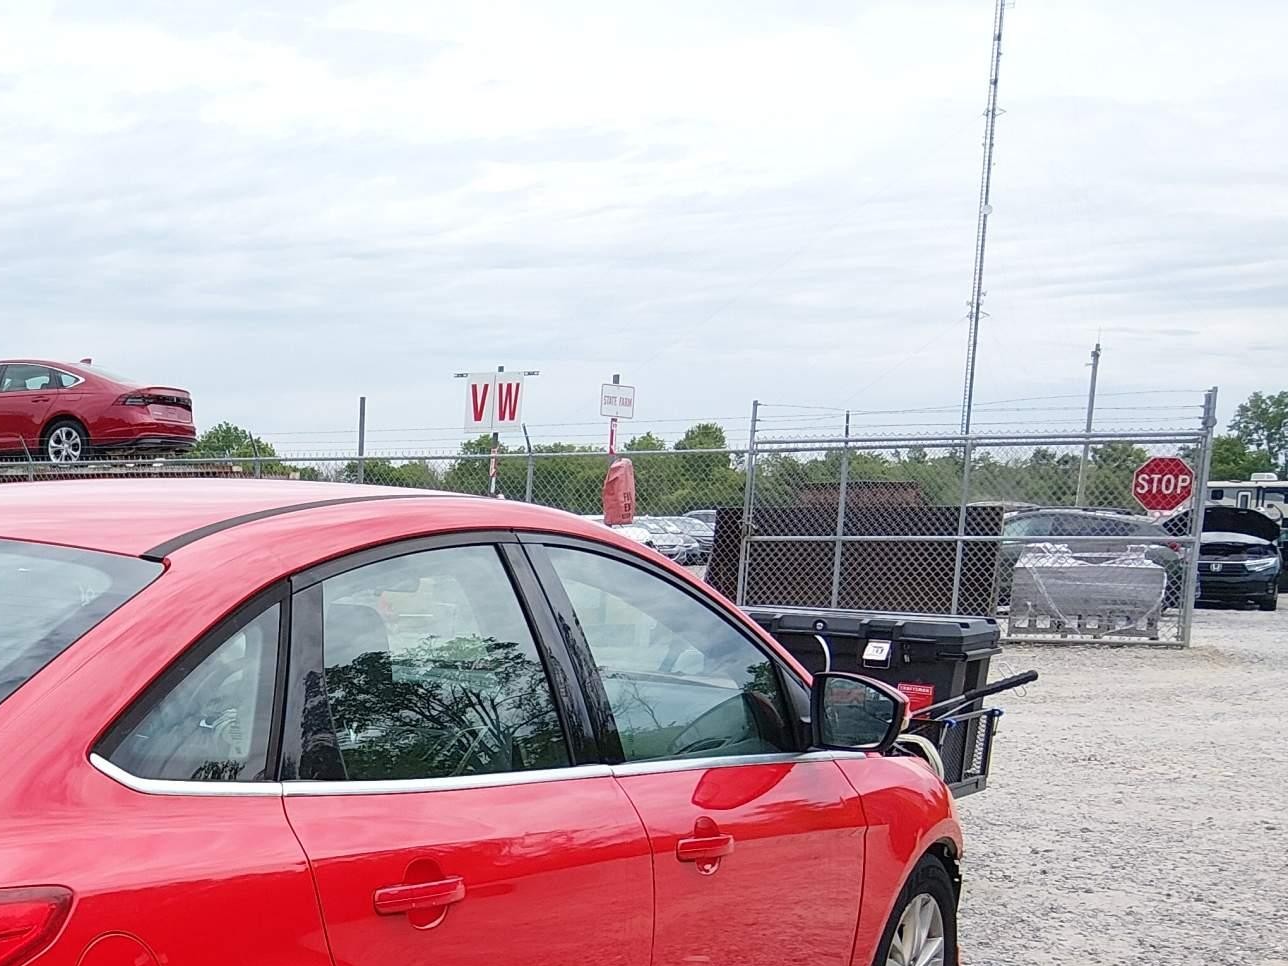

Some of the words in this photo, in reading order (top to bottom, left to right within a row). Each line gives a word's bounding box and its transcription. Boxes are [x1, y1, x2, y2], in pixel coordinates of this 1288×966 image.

[603, 395, 618, 406] STATE
[619, 396, 633, 407] FARM
[1135, 473, 1191, 495] STOP
